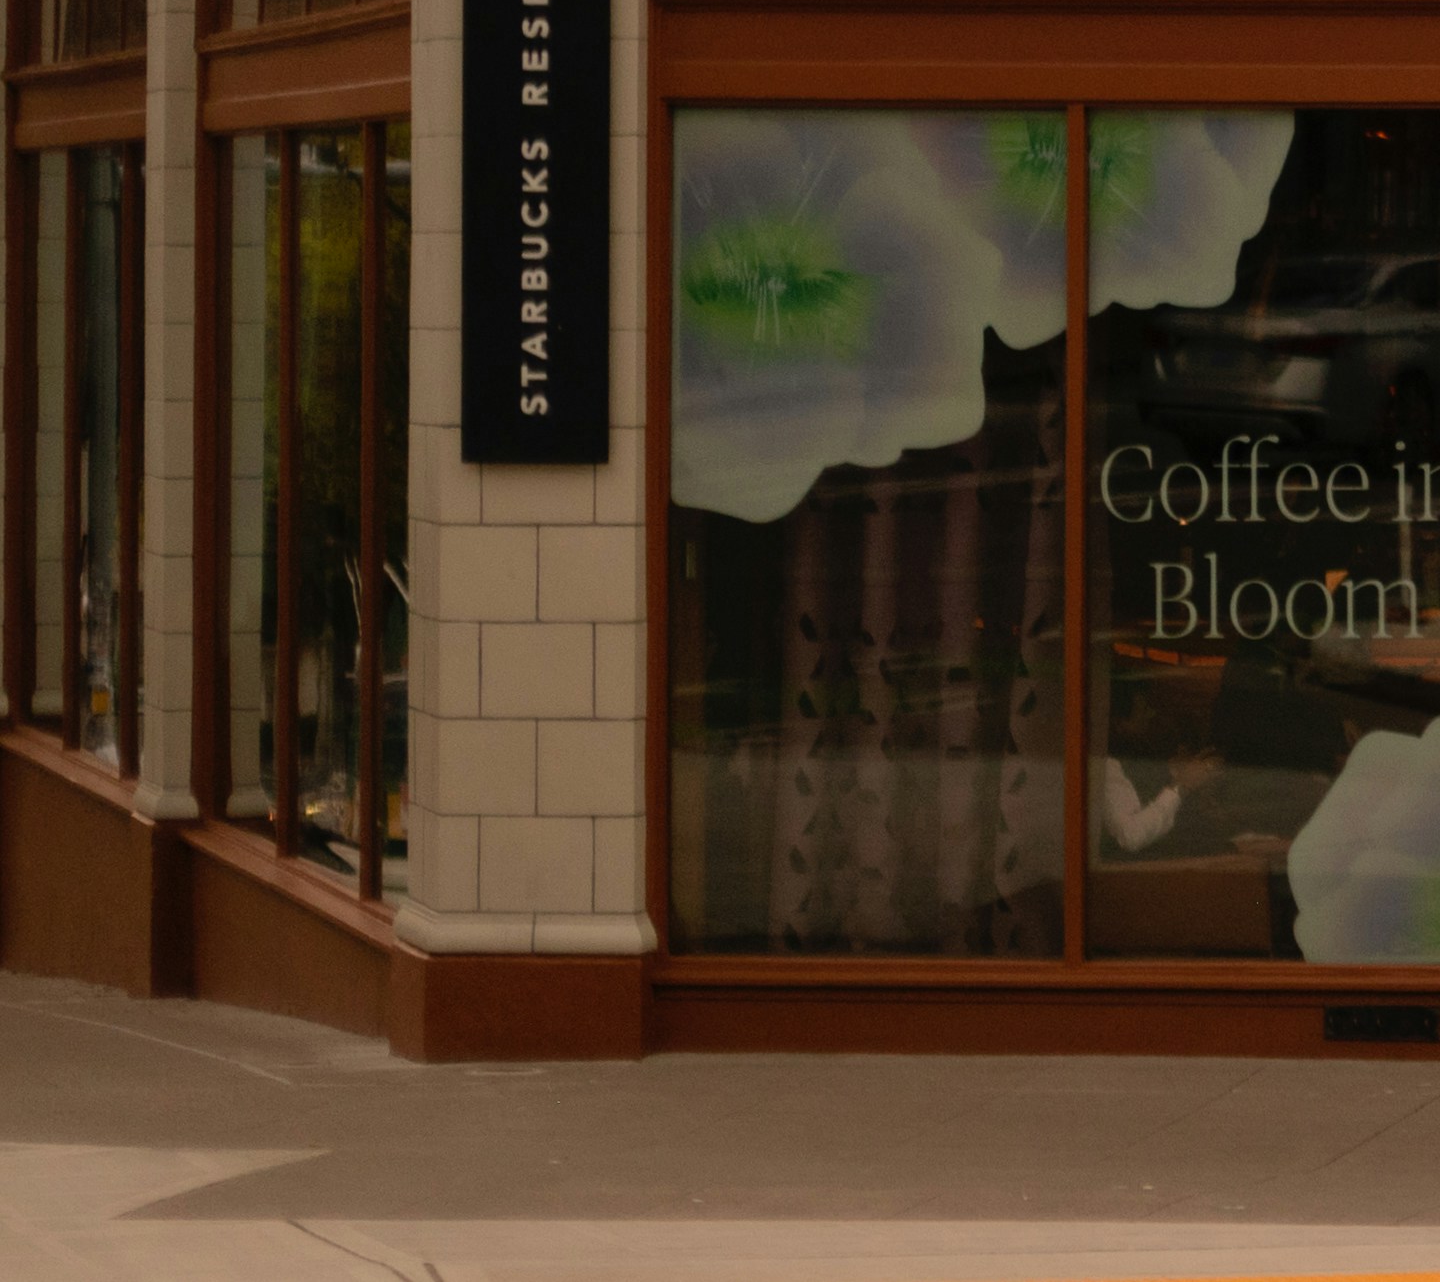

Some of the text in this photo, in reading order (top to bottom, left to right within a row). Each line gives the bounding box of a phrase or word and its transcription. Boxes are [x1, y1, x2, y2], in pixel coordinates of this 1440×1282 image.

[521, 137, 550, 416] STARBUCKS
[1101, 434, 1371, 524] Coffee
[1149, 552, 1424, 641] Bloom
